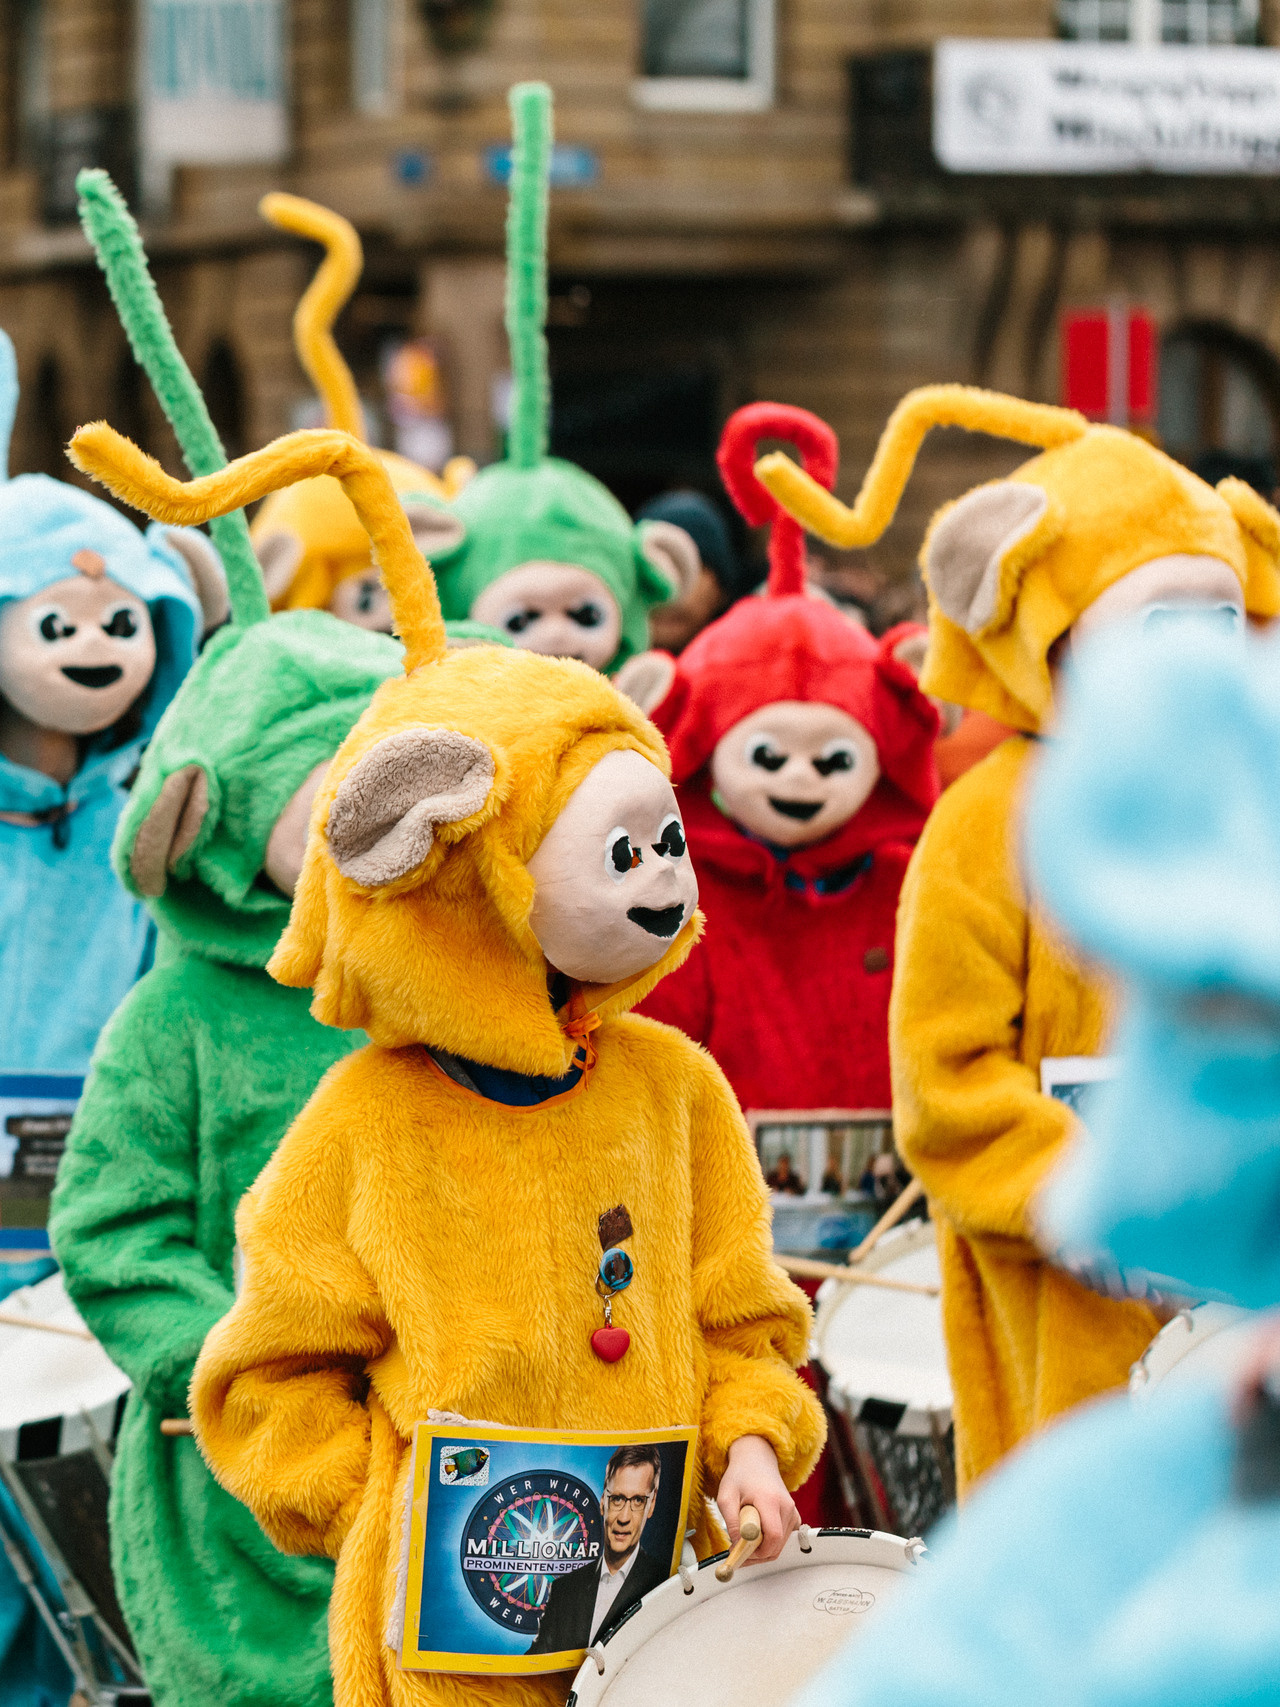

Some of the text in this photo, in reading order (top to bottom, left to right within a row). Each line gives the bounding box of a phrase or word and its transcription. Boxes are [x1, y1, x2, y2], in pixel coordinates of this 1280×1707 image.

[494, 1479, 590, 1507] WER WIRD
[467, 1537, 600, 1559] MILLIONÄR
[466, 1559, 589, 1572] PROMINENTEN-SPEC
[489, 1597, 523, 1625] WER
